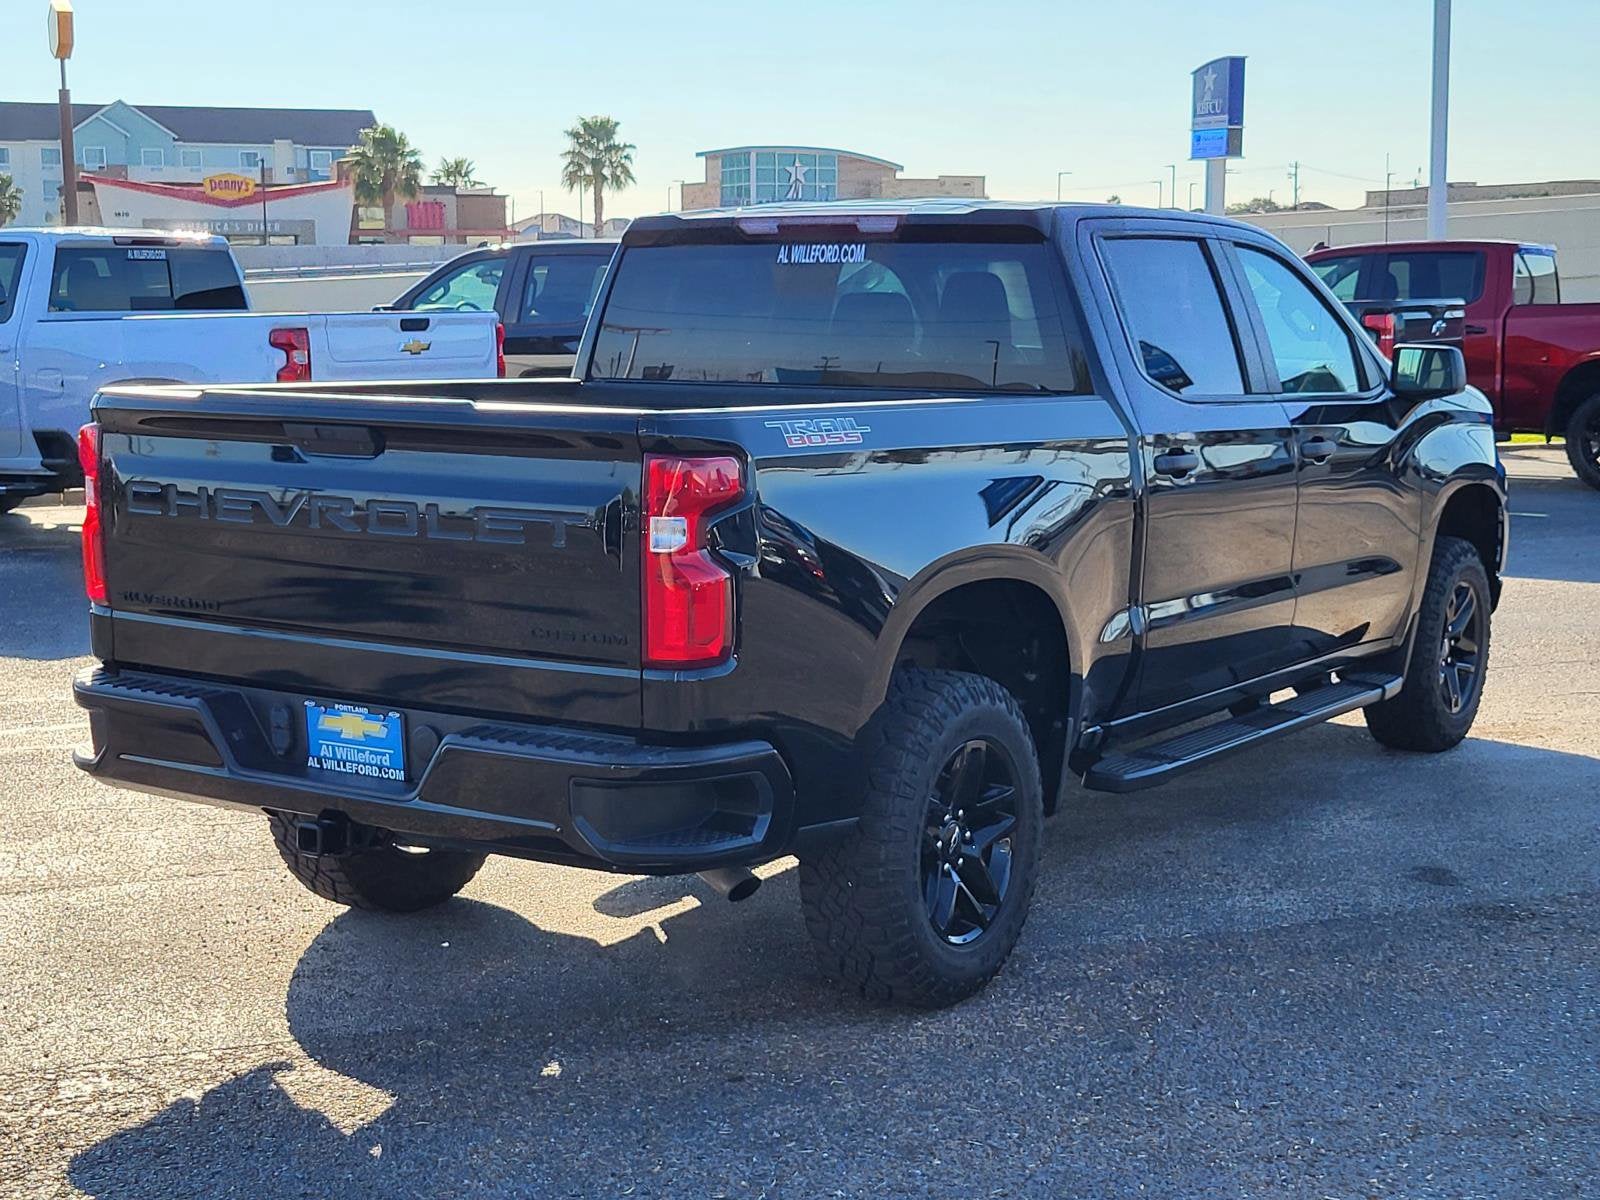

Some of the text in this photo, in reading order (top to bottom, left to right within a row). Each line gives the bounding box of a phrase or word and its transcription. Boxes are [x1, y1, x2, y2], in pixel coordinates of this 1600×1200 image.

[208, 178, 250, 193] Denny's
[777, 243, 866, 264] AL WILLEFORD.COM
[764, 417, 871, 435] TRAIL
[785, 431, 863, 448] BOSS
[125, 480, 591, 549] CHEVROLET
[334, 703, 369, 714] PORTLAND
[320, 744, 390, 766] Al Willeford
[307, 756, 405, 781] AL WILLEFORD.COM
